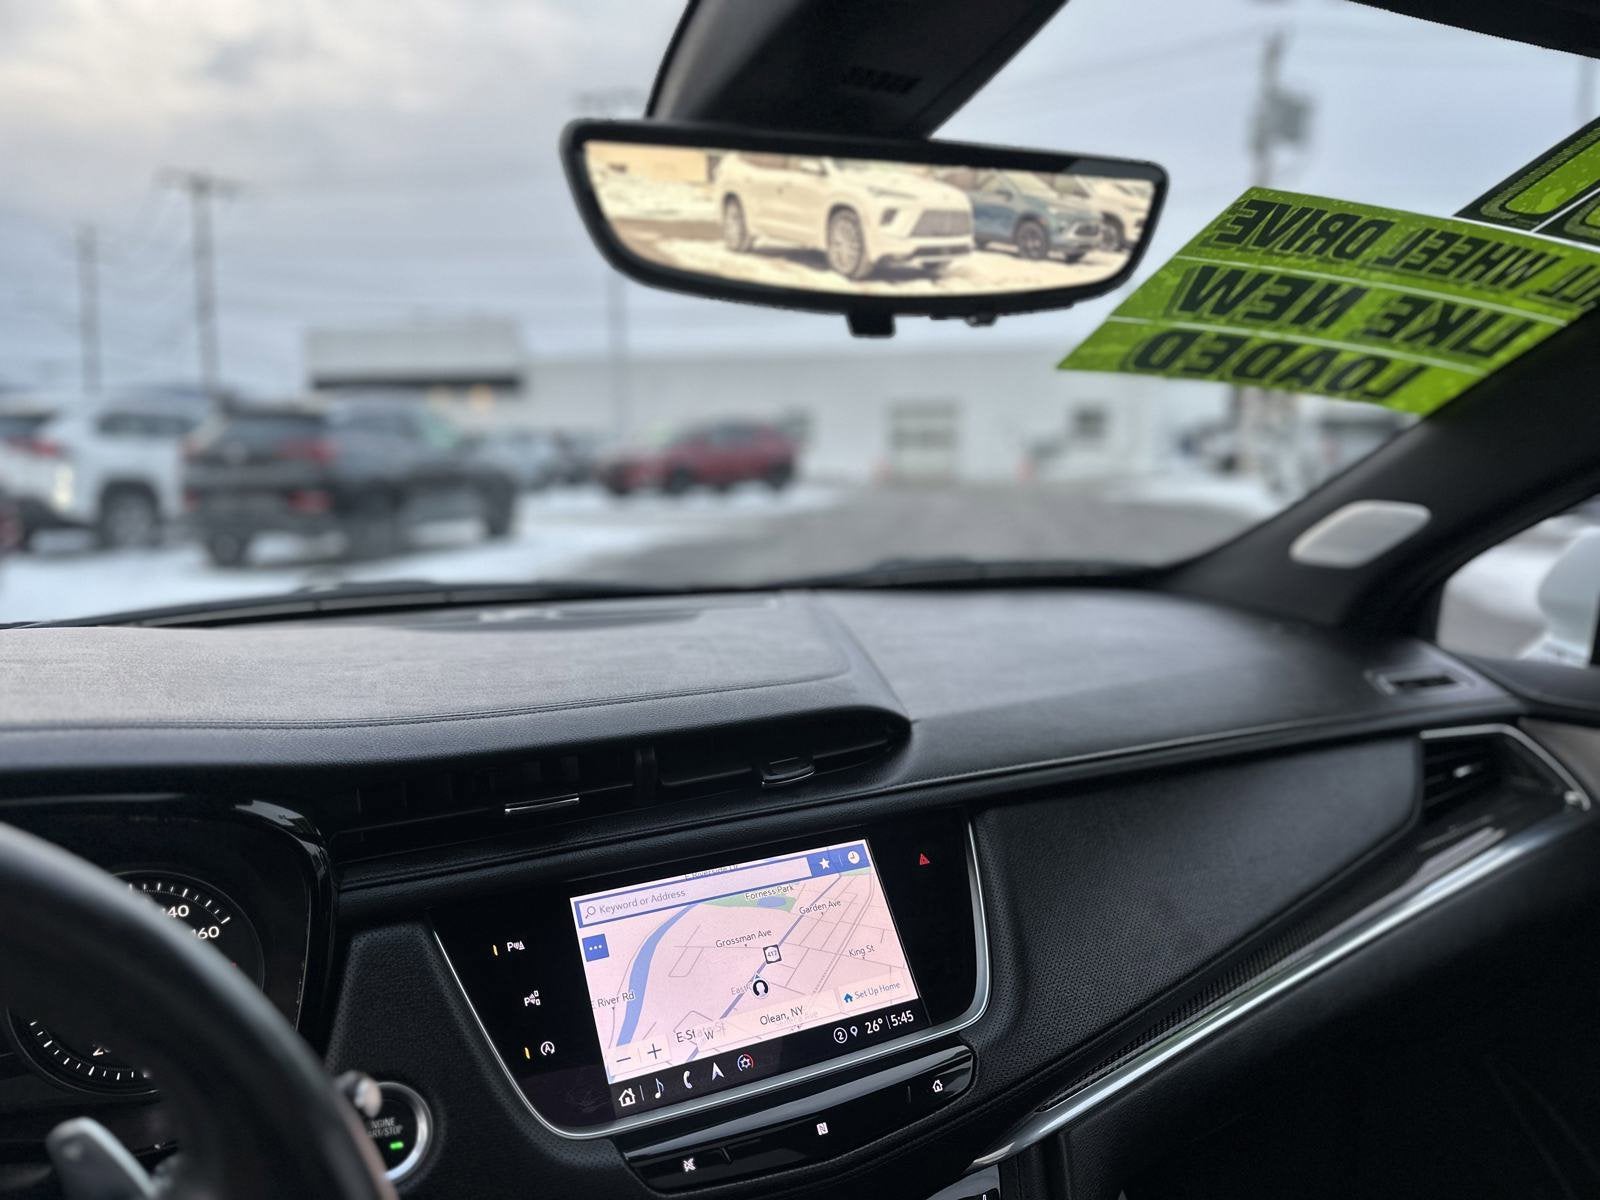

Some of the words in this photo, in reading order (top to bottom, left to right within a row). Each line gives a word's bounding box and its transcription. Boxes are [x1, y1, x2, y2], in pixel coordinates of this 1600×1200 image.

[599, 897, 638, 915] Keyword
[639, 896, 649, 906] or
[650, 889, 687, 904] Address
[745, 887, 777, 901] Forness
[777, 884, 794, 896] Park
[799, 902, 827, 915] Garden
[827, 899, 842, 909] Ave
[715, 933, 757, 949] Grossman
[757, 928, 773, 940] Ave
[848, 945, 865, 959] King
[865, 944, 875, 954] St
[597, 996, 620, 1008] River
[621, 991, 636, 1001] Rd
[854, 990, 867, 1000] Set
[868, 986, 880, 996] Up
[879, 981, 901, 994] Home
[759, 1011, 791, 1026] Olean,
[790, 1005, 804, 1019] NY
[864, 1017, 884, 1034] 26°
[890, 1009, 914, 1027] 5:45
